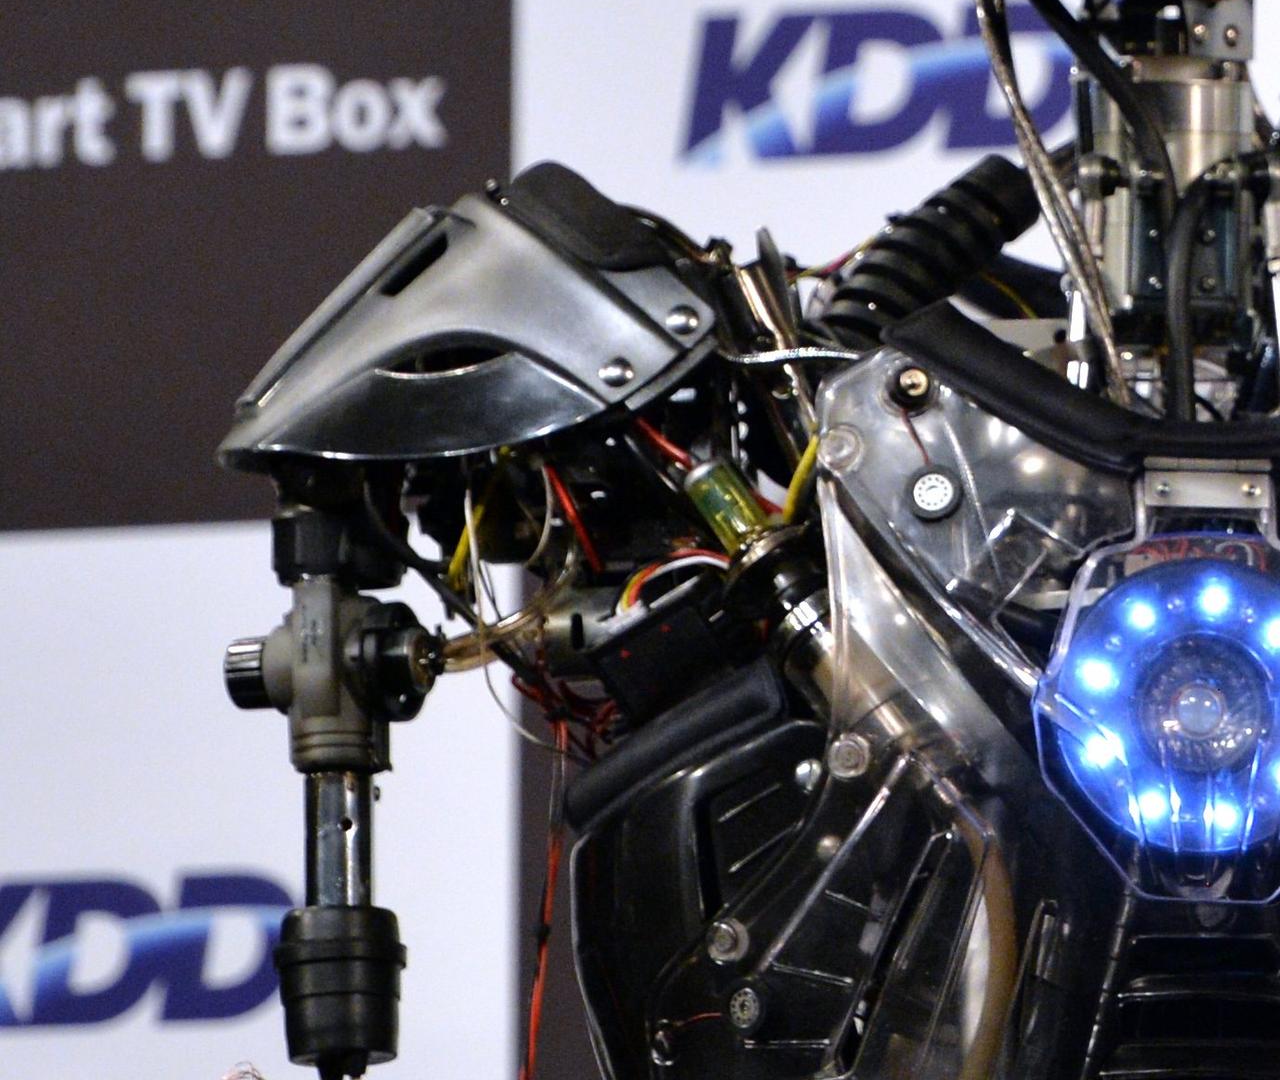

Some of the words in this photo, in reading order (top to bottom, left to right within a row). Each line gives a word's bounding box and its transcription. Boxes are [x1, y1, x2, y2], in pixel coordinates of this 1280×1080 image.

[0, 75, 117, 170] art
[124, 67, 253, 163] TV
[265, 62, 447, 156] Box
[678, 2, 1085, 167] KDD
[0, 870, 294, 1028] DD
